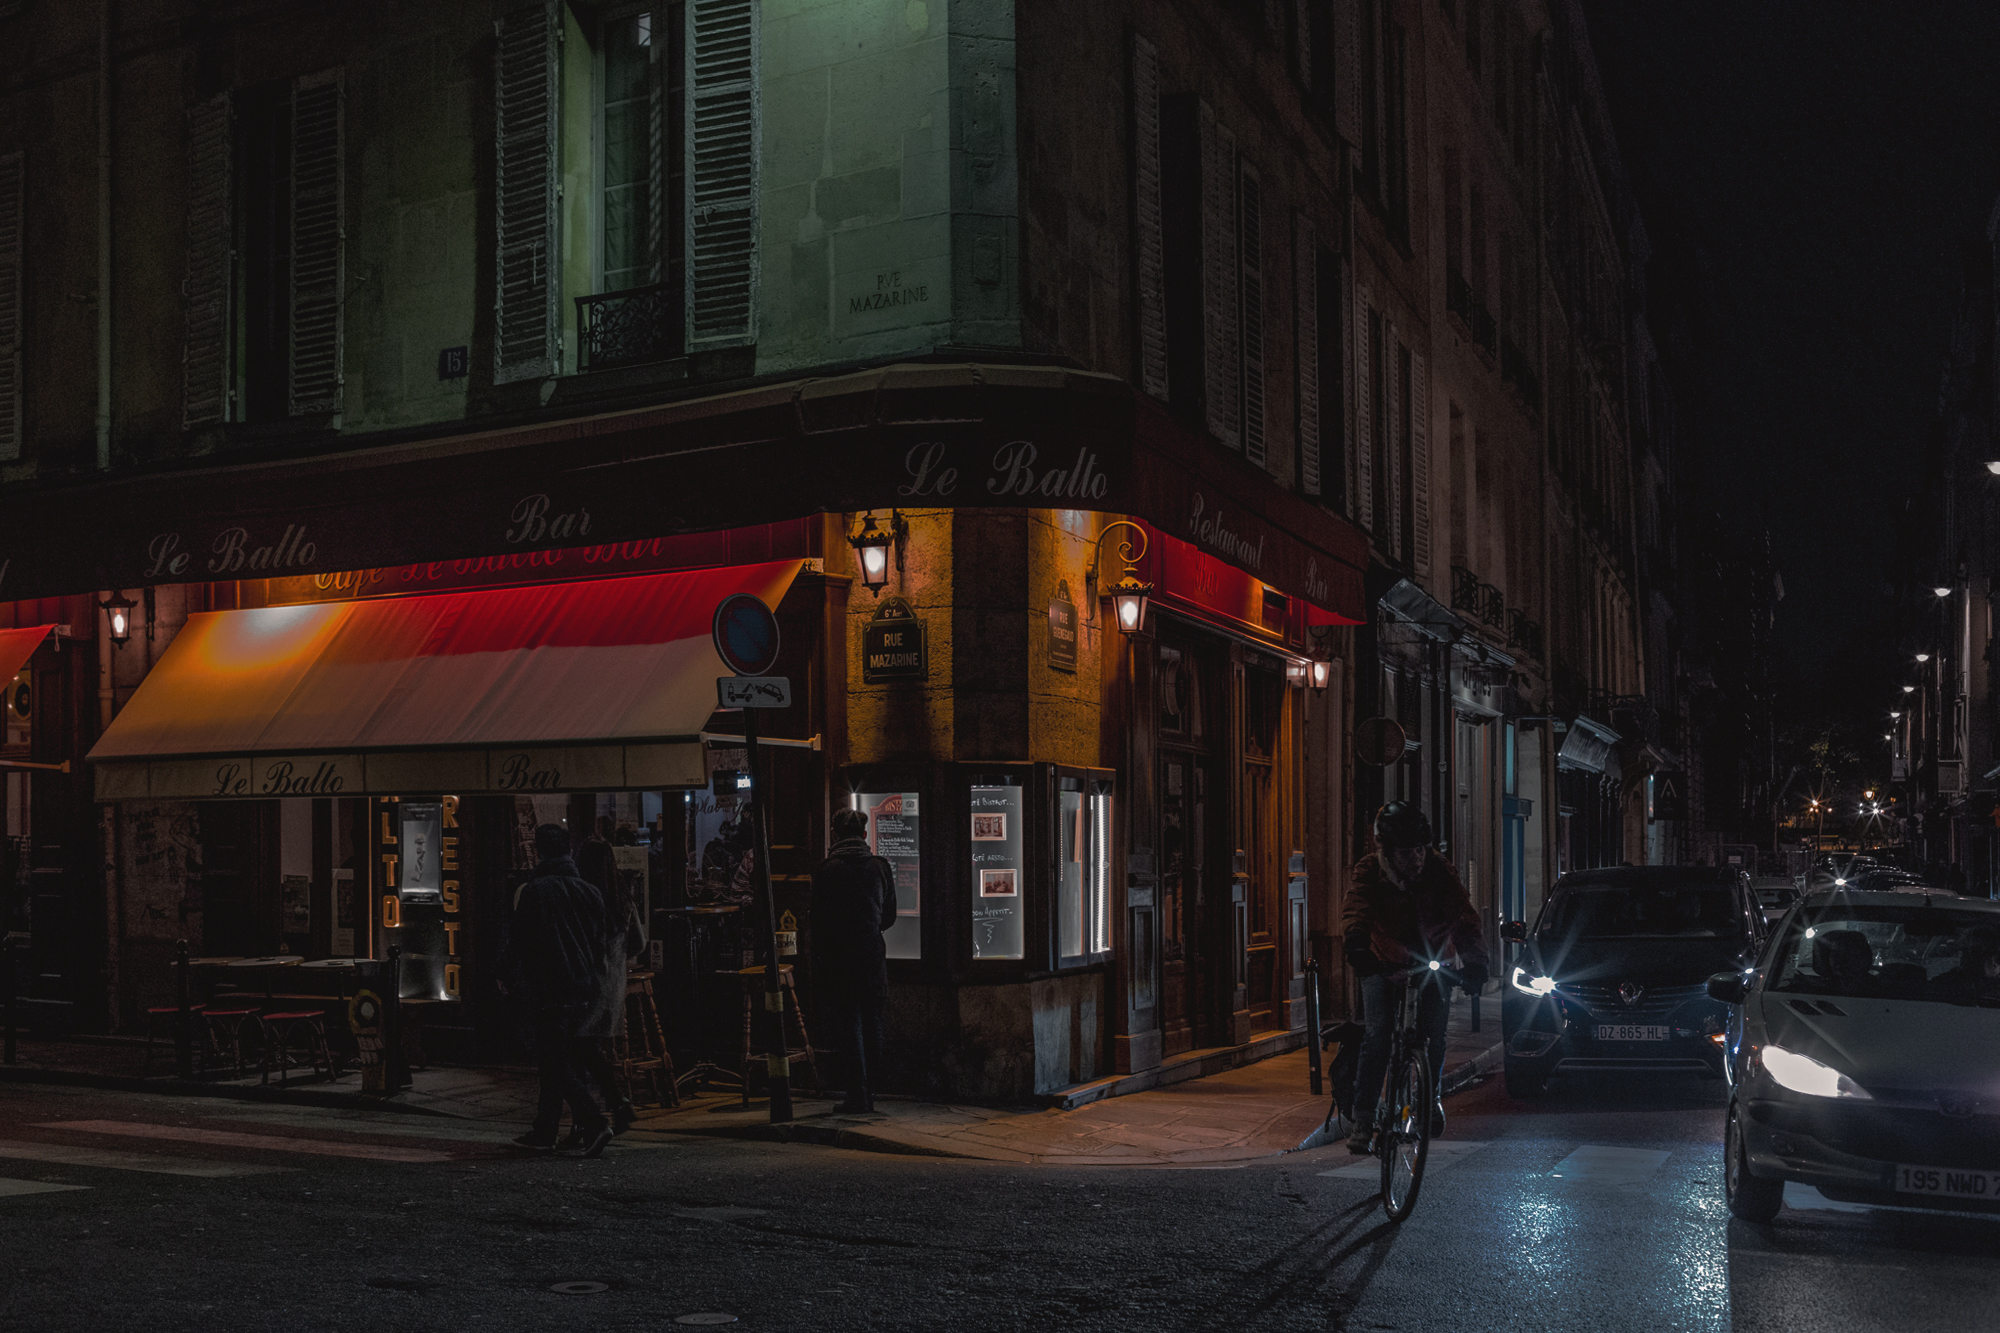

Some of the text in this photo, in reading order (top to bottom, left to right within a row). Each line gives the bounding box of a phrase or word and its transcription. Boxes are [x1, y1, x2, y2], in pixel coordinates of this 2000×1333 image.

[849, 286, 929, 314] MAZARINE
[447, 351, 461, 373] 15
[897, 442, 958, 496] Le
[505, 494, 592, 544] Bar
[1190, 492, 1264, 570] Restaurant
[143, 532, 190, 578] Le
[1305, 556, 1327, 602] Bar
[869, 652, 919, 668] MAZARINE
[884, 632, 904, 647] RUE
[211, 762, 248, 797] Le
[498, 754, 564, 791] Bar
[381, 796, 400, 928] LTO
[441, 795, 461, 997] RESTO
[1902, 1168, 1940, 1191] 195
[1945, 1172, 1987, 1195] NWD
